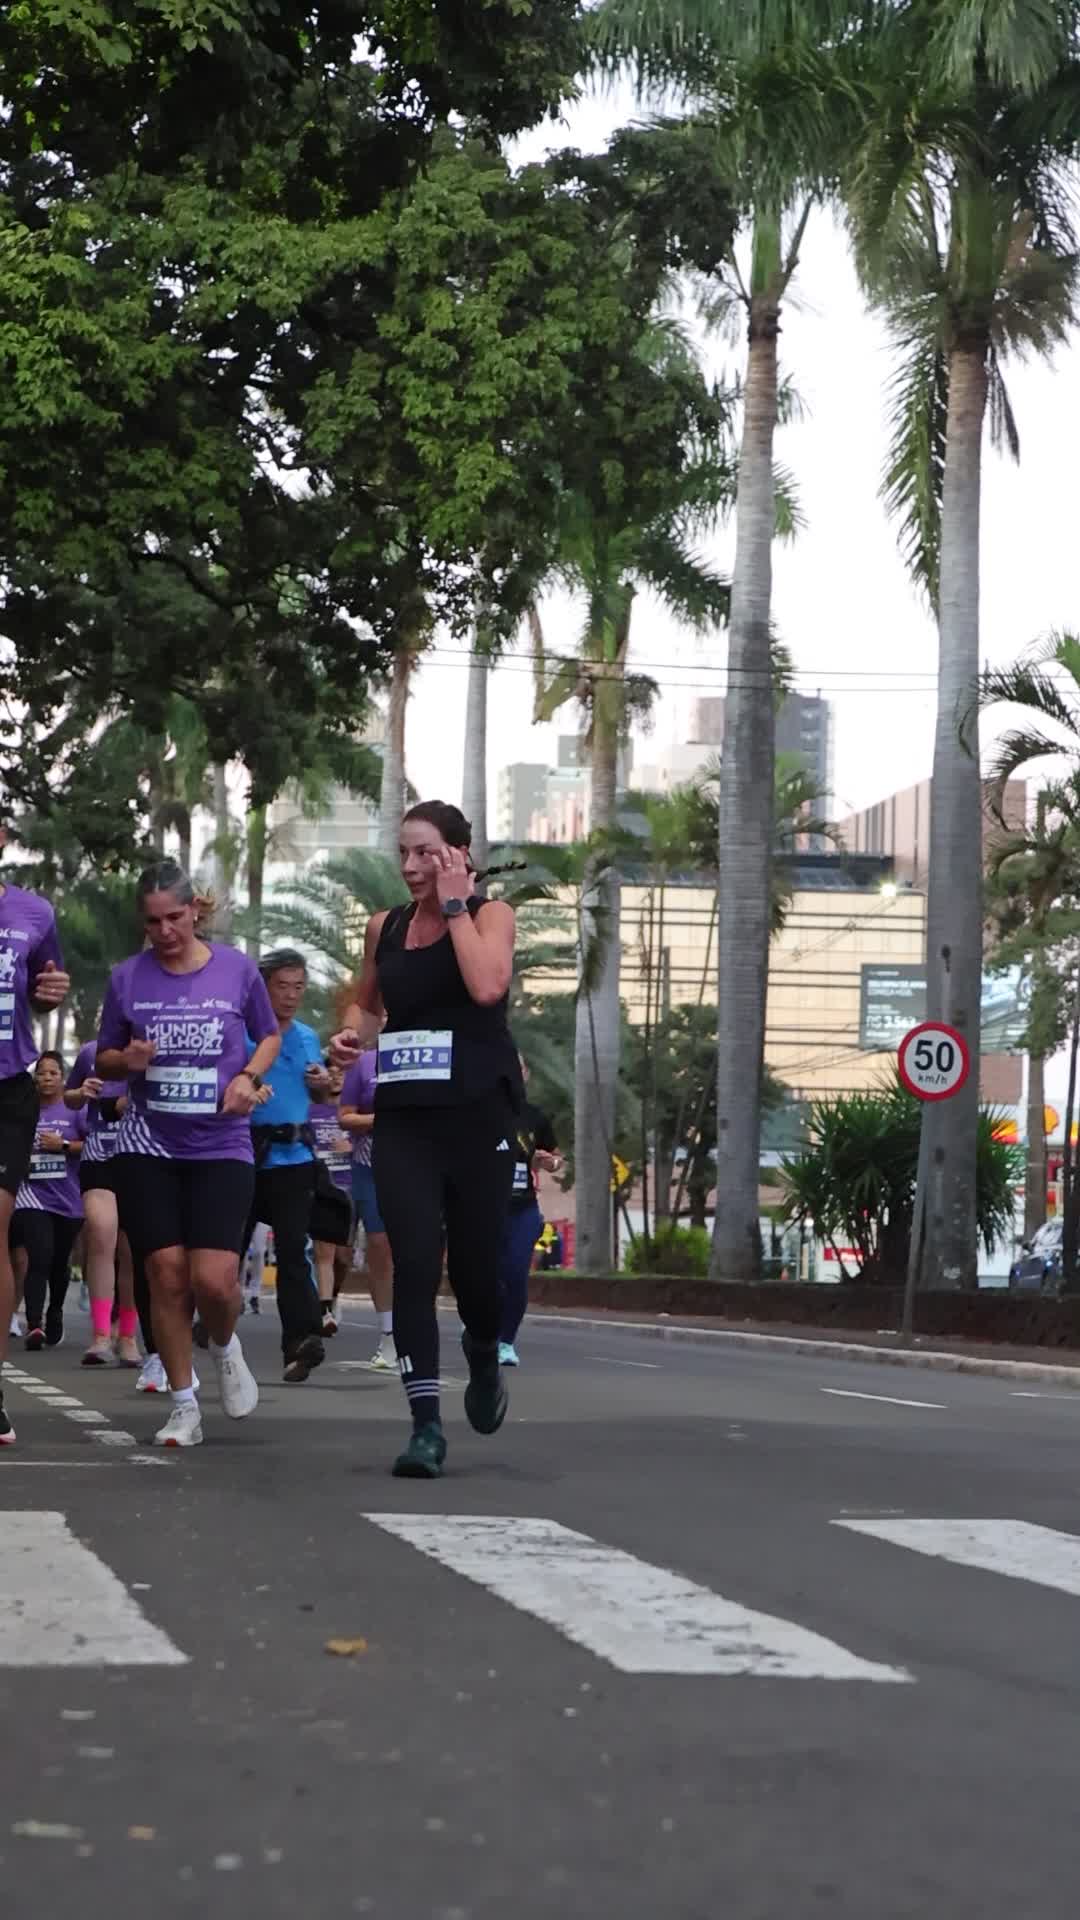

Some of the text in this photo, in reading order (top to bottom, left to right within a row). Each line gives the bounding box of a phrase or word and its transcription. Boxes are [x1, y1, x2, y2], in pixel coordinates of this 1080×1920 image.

[145, 1023, 218, 1037] MUNDO
[391, 1048, 433, 1066] 6212
[915, 1040, 954, 1072] 50
[918, 1074, 948, 1085] km/h
[159, 1083, 200, 1098] 5231
